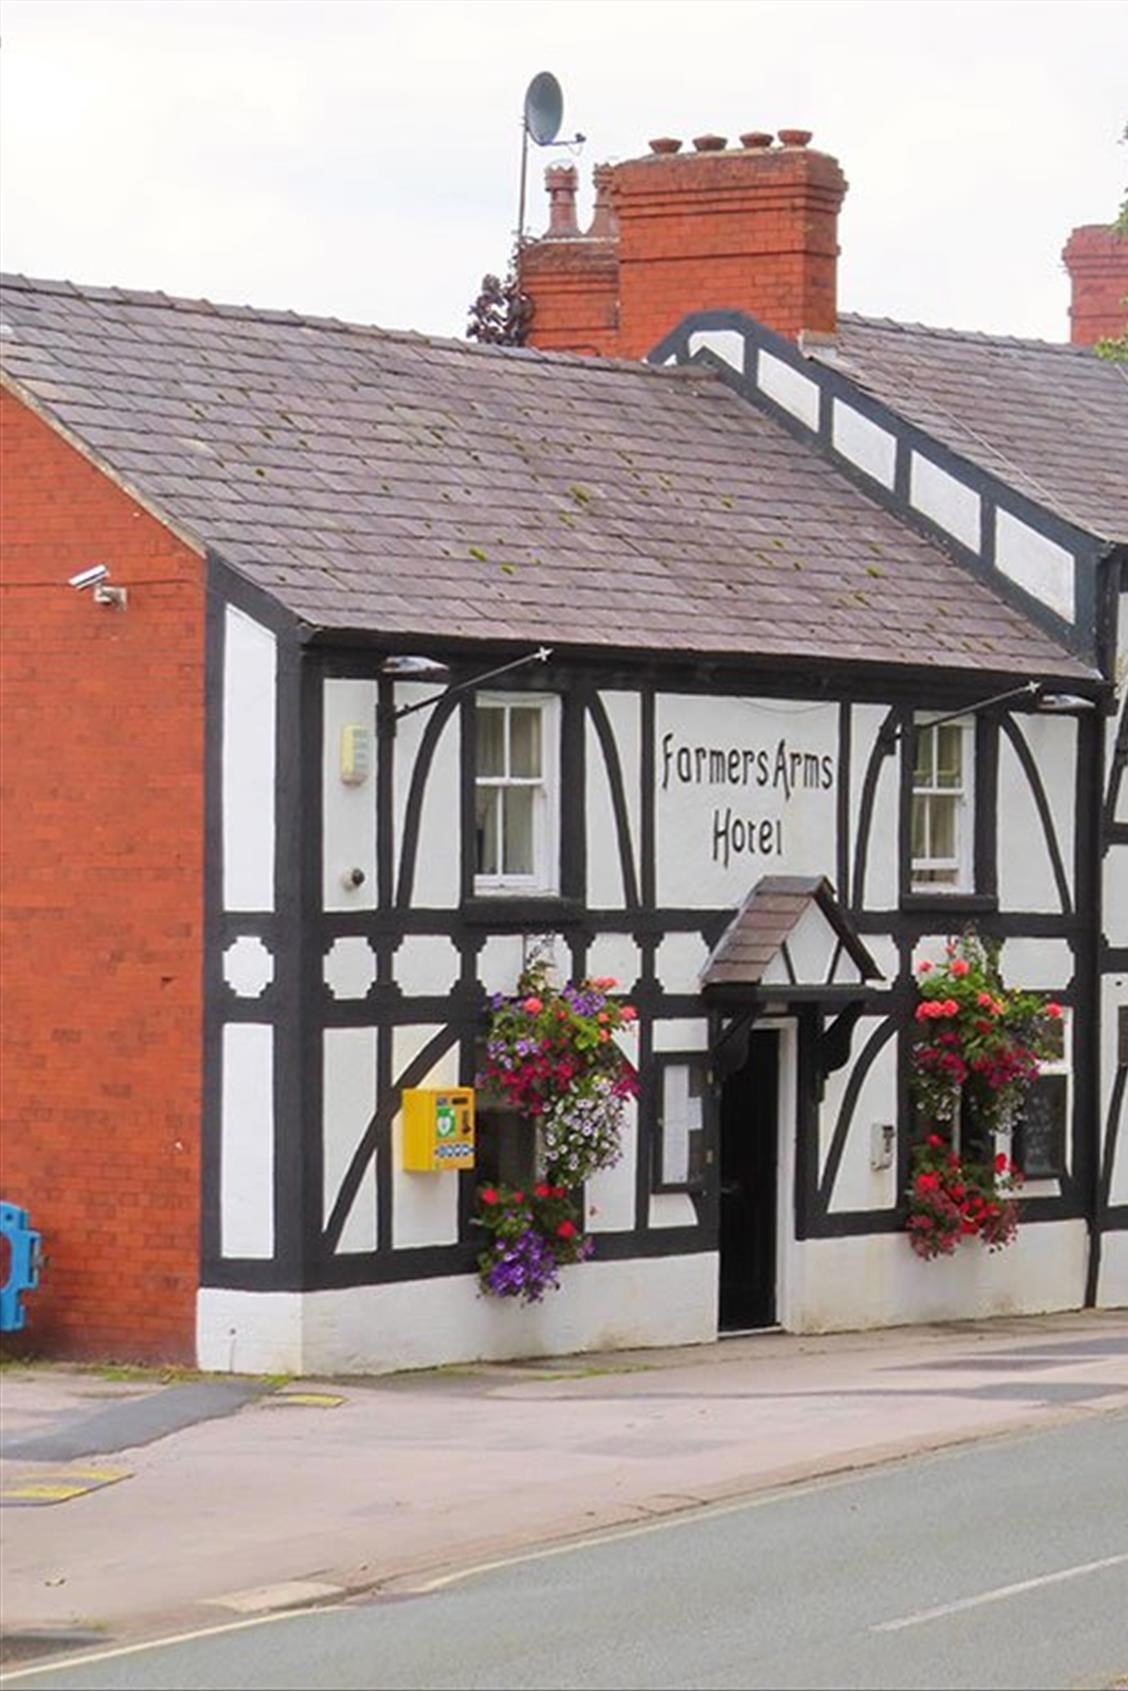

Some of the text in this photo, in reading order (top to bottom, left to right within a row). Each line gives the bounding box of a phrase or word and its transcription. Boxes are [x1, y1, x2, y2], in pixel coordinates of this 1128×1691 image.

[662, 732, 833, 801] Farmers Arms
[713, 807, 782, 869] Hotel
